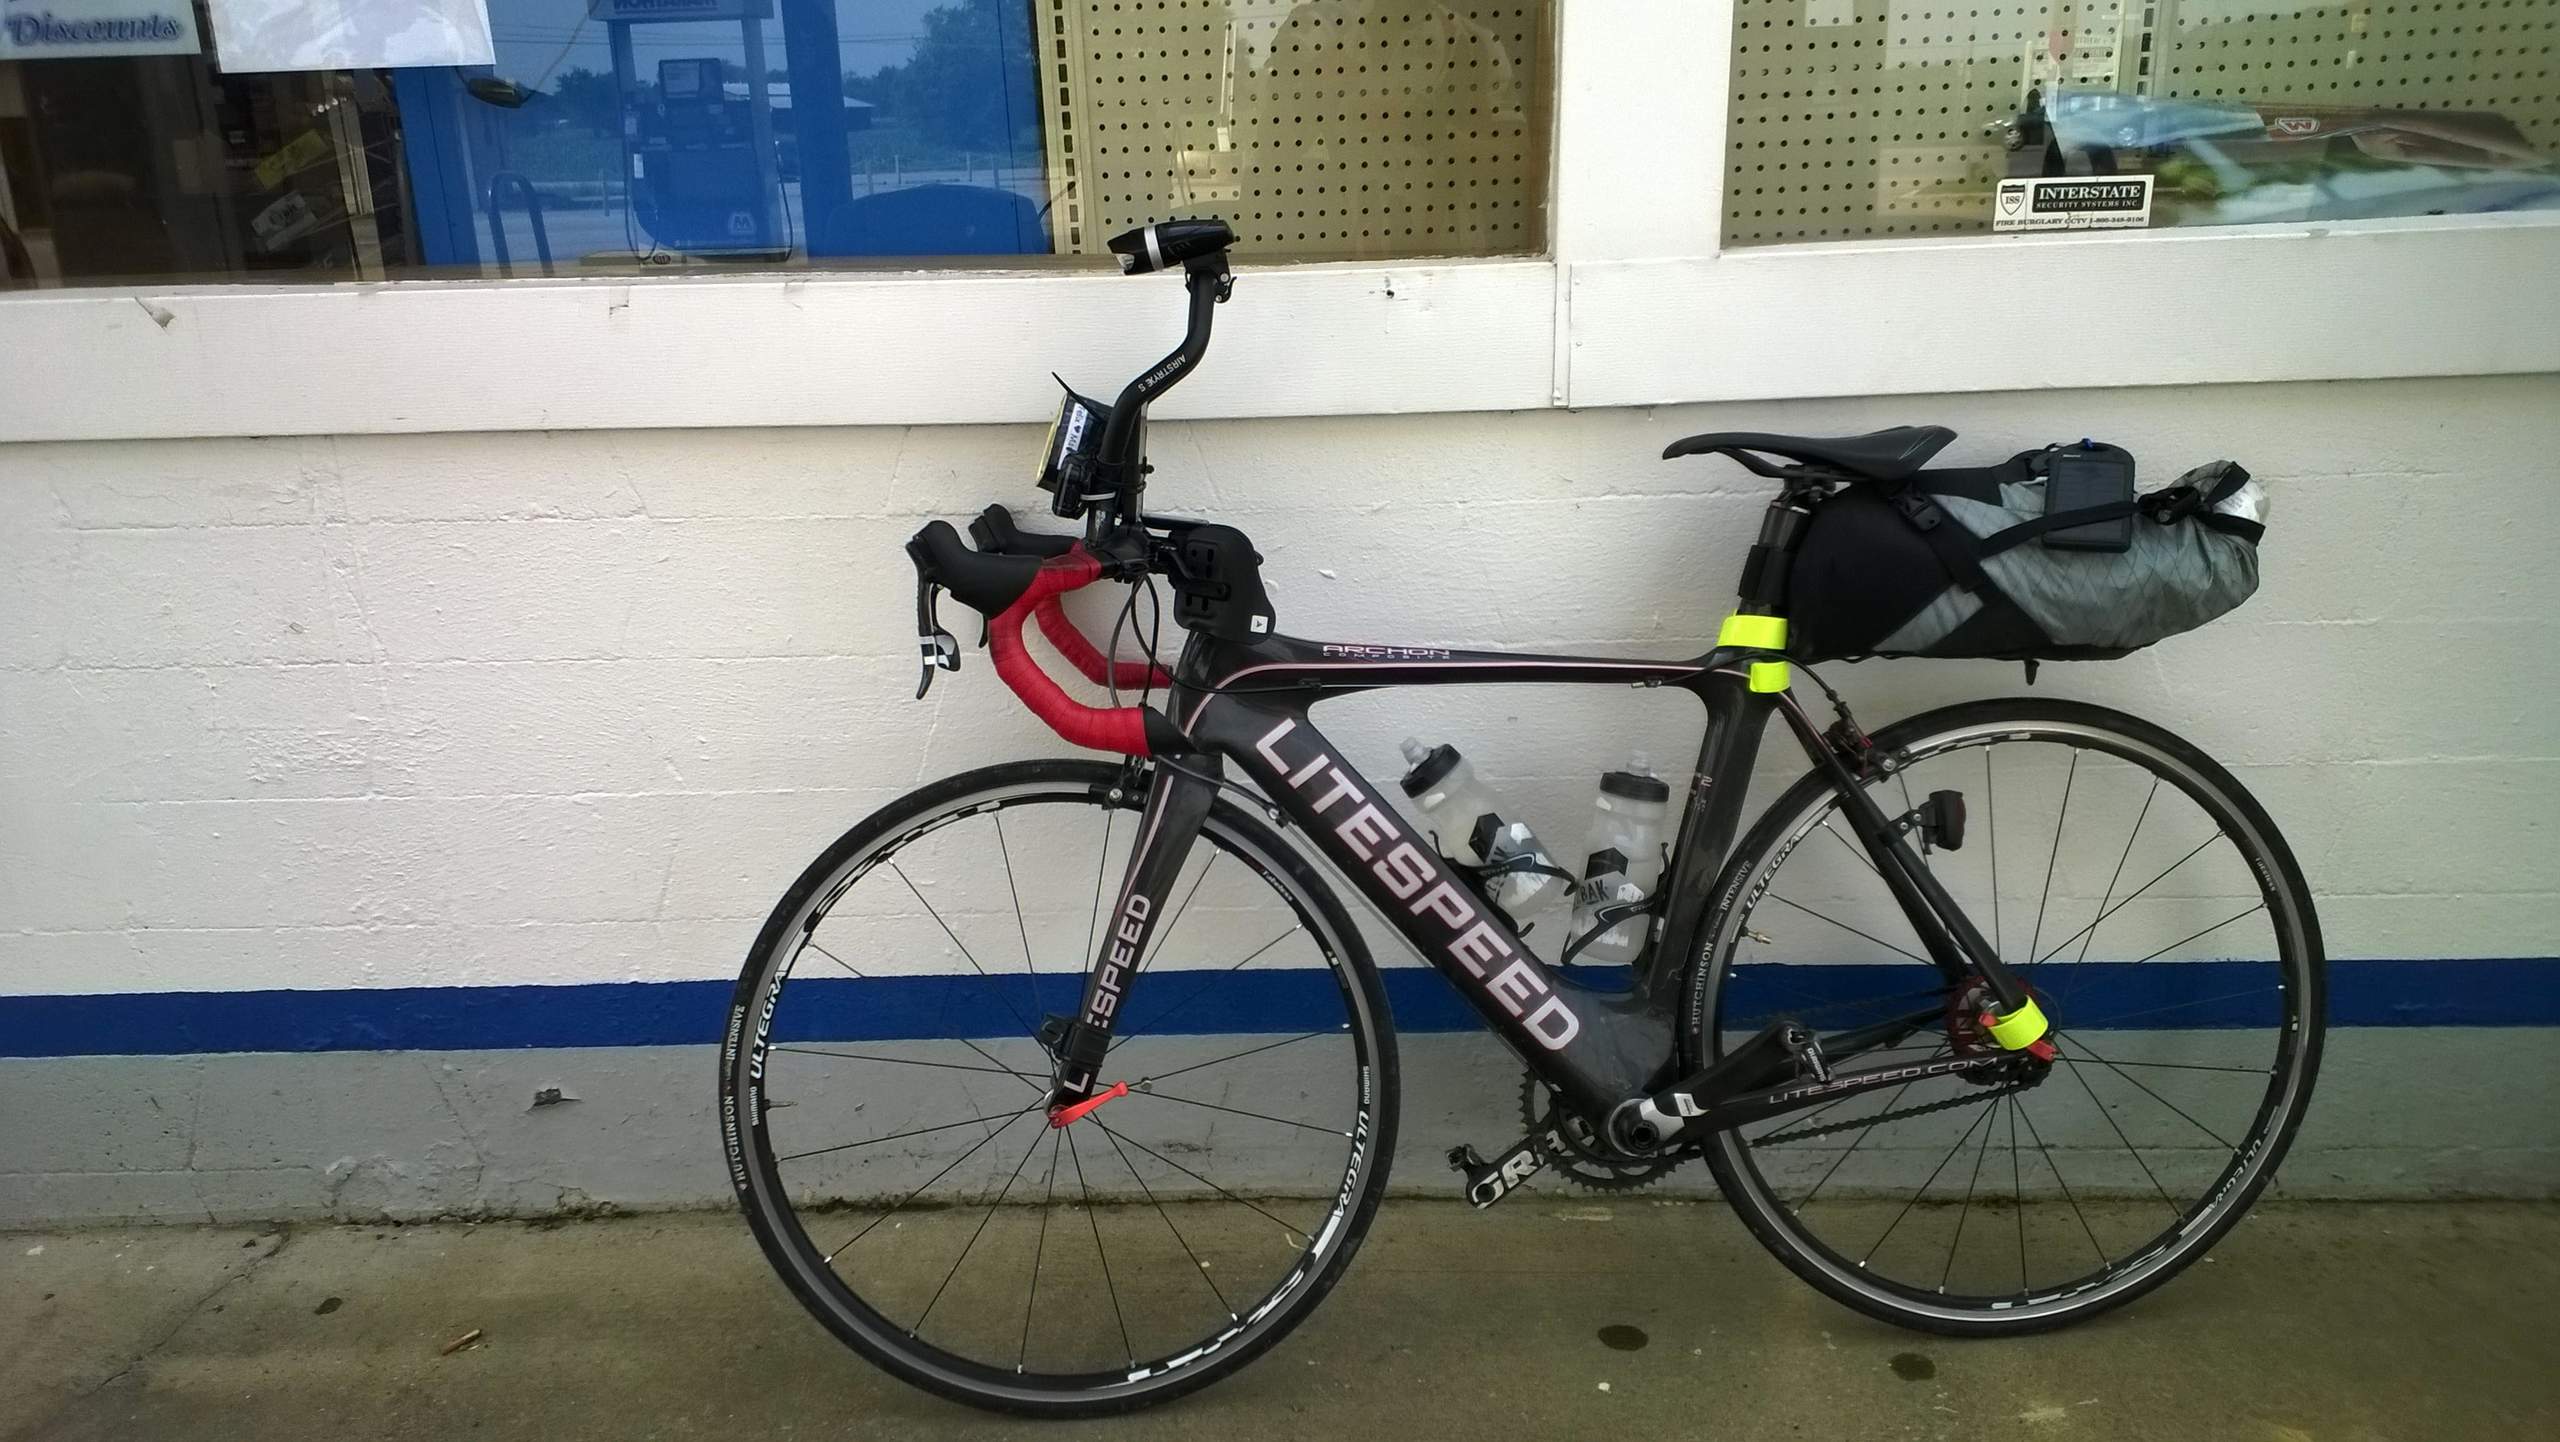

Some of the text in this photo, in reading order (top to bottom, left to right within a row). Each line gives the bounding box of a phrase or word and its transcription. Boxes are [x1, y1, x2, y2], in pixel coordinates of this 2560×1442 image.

[6, 12, 182, 46] Discounts
[2005, 195, 2021, 205] ISS
[2036, 201, 2079, 209] SECURITY
[2081, 200, 2119, 208] SYSTEMS
[2039, 185, 2141, 200] INTERSTATE
[1996, 219, 2015, 227] FIRE
[2017, 218, 2063, 226] BURGLARY
[1145, 353, 1186, 388] AIRSTRYKE
[1323, 644, 1451, 656] ARCHON
[1323, 652, 1451, 660] COMPOSITE
[1256, 717, 1579, 1050] LITESPEED
[1720, 860, 1753, 912] INTENSIVE
[1747, 835, 1800, 909] ULTEGRA
[1692, 942, 1714, 1025] HUTCHINSON
[725, 1004, 746, 1061] INTENSIVE
[750, 970, 787, 1080] ULTEGRA
[1362, 1065, 1371, 1105] SHIMANO
[1770, 1056, 1998, 1104] LITESPEED.COM
[750, 1086, 760, 1127] SHIMANO
[723, 1096, 747, 1182] HUTCHINSON
[1333, 1110, 1370, 1218] ULTEGRA
